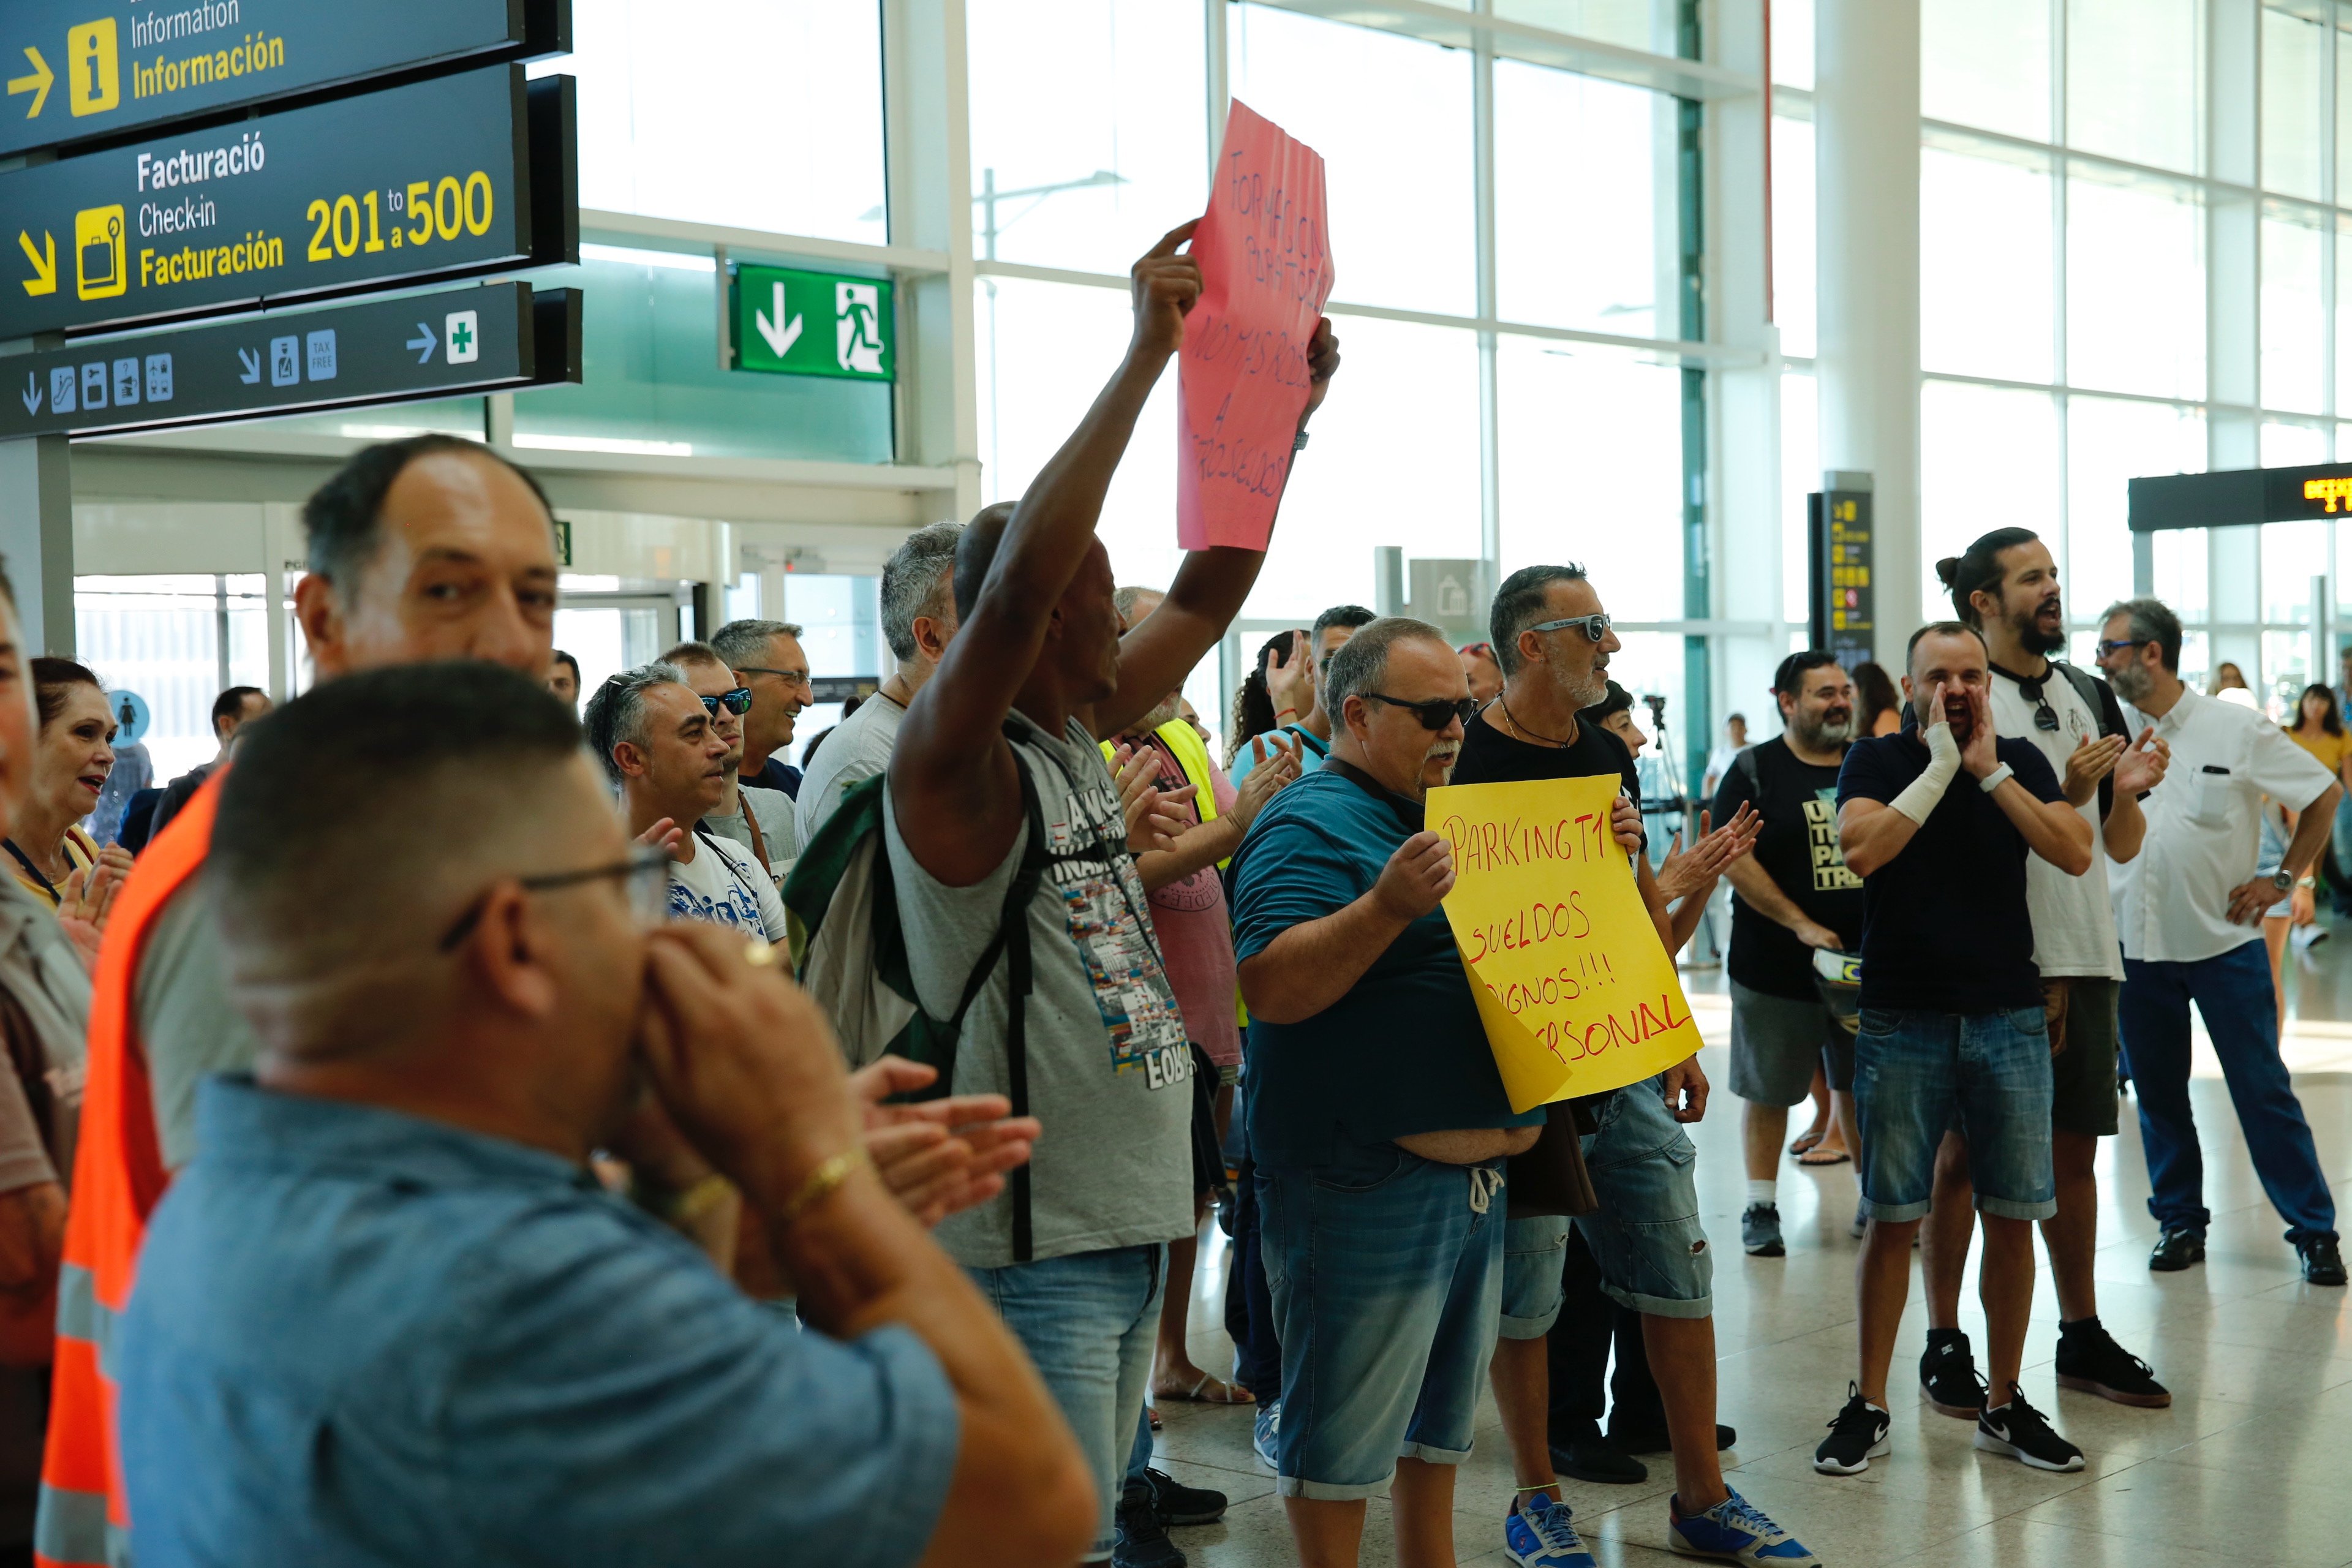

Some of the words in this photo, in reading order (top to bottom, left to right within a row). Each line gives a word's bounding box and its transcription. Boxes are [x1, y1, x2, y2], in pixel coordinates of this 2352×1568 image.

[132, 0, 239, 48] Information
[133, 31, 284, 99] Información
[137, 130, 265, 192] Facturació
[139, 194, 216, 237] Check-in
[306, 189, 385, 262] 201
[388, 189, 404, 212] to
[407, 170, 494, 246] 500
[391, 226, 403, 249] a
[140, 229, 284, 287] Facturación
[312, 355, 332, 369] FREE
[313, 341, 331, 353] TAX
[1442, 815, 1572, 876] PARKING
[1469, 891, 1591, 963] SUELDOS
